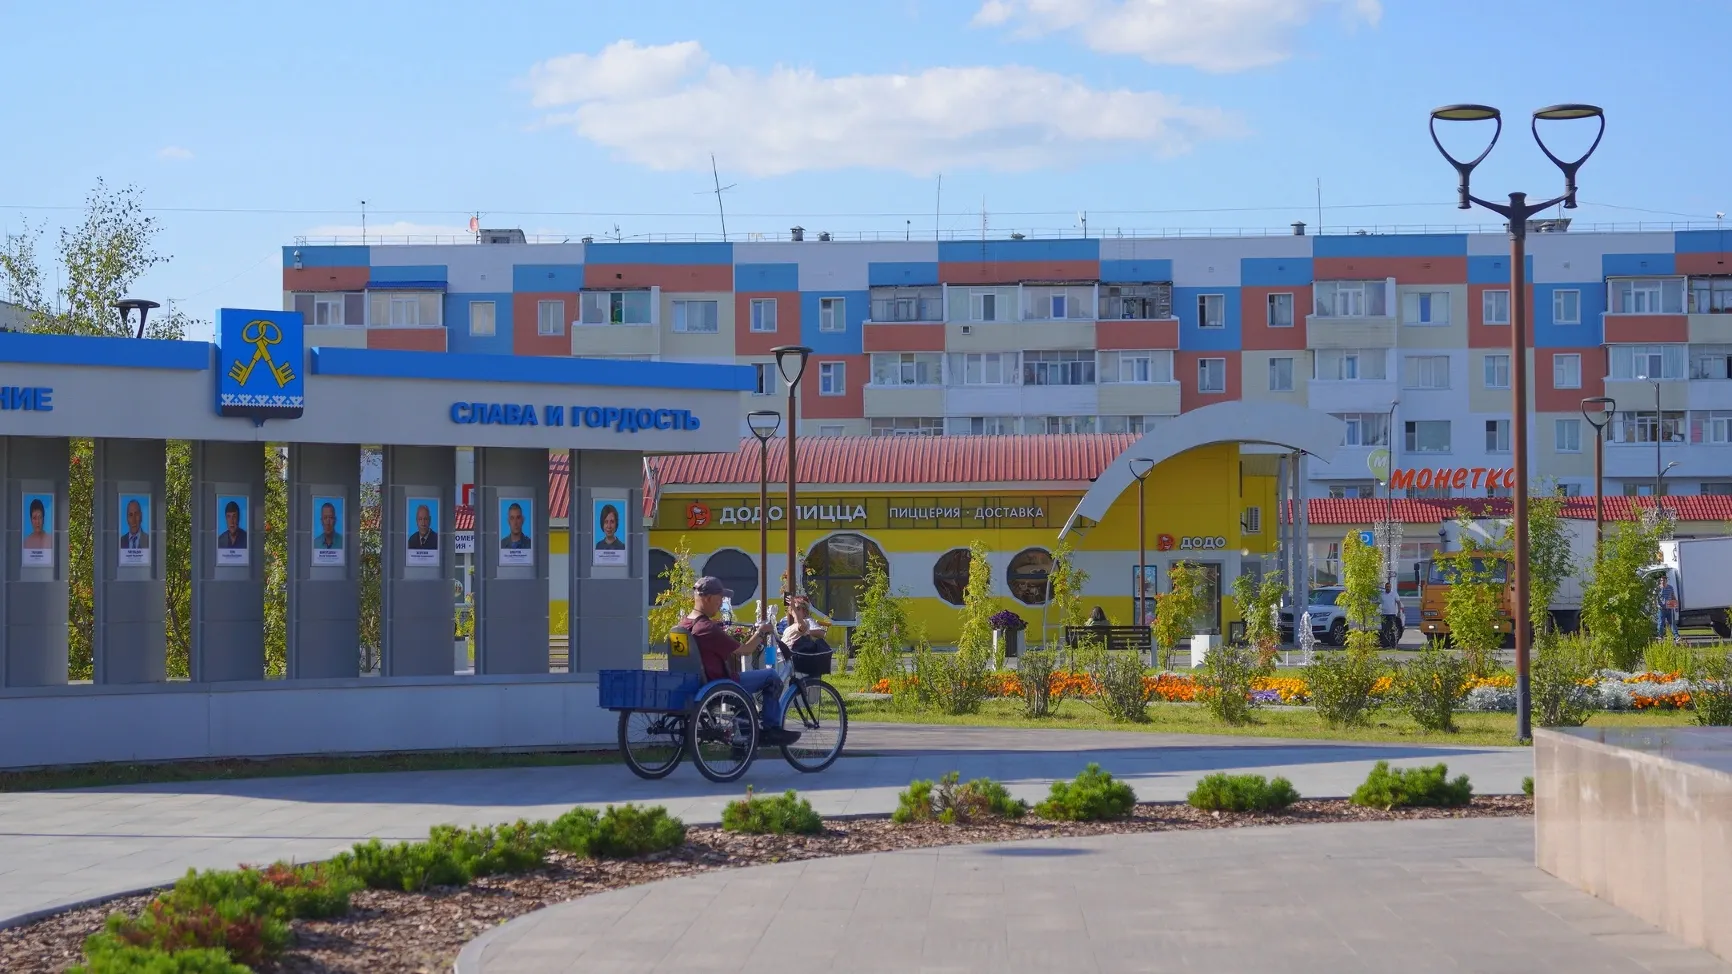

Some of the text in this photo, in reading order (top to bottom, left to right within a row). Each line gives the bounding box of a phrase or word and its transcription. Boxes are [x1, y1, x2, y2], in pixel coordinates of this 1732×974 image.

[450, 402, 701, 433] СЛАВА И ГОРДОСТЬ
[719, 506, 783, 525] ДОДО
[889, 507, 1044, 520] ПИЦЦЕРИЯ ДОСТАВКА
[1180, 536, 1226, 550] ДОДО
